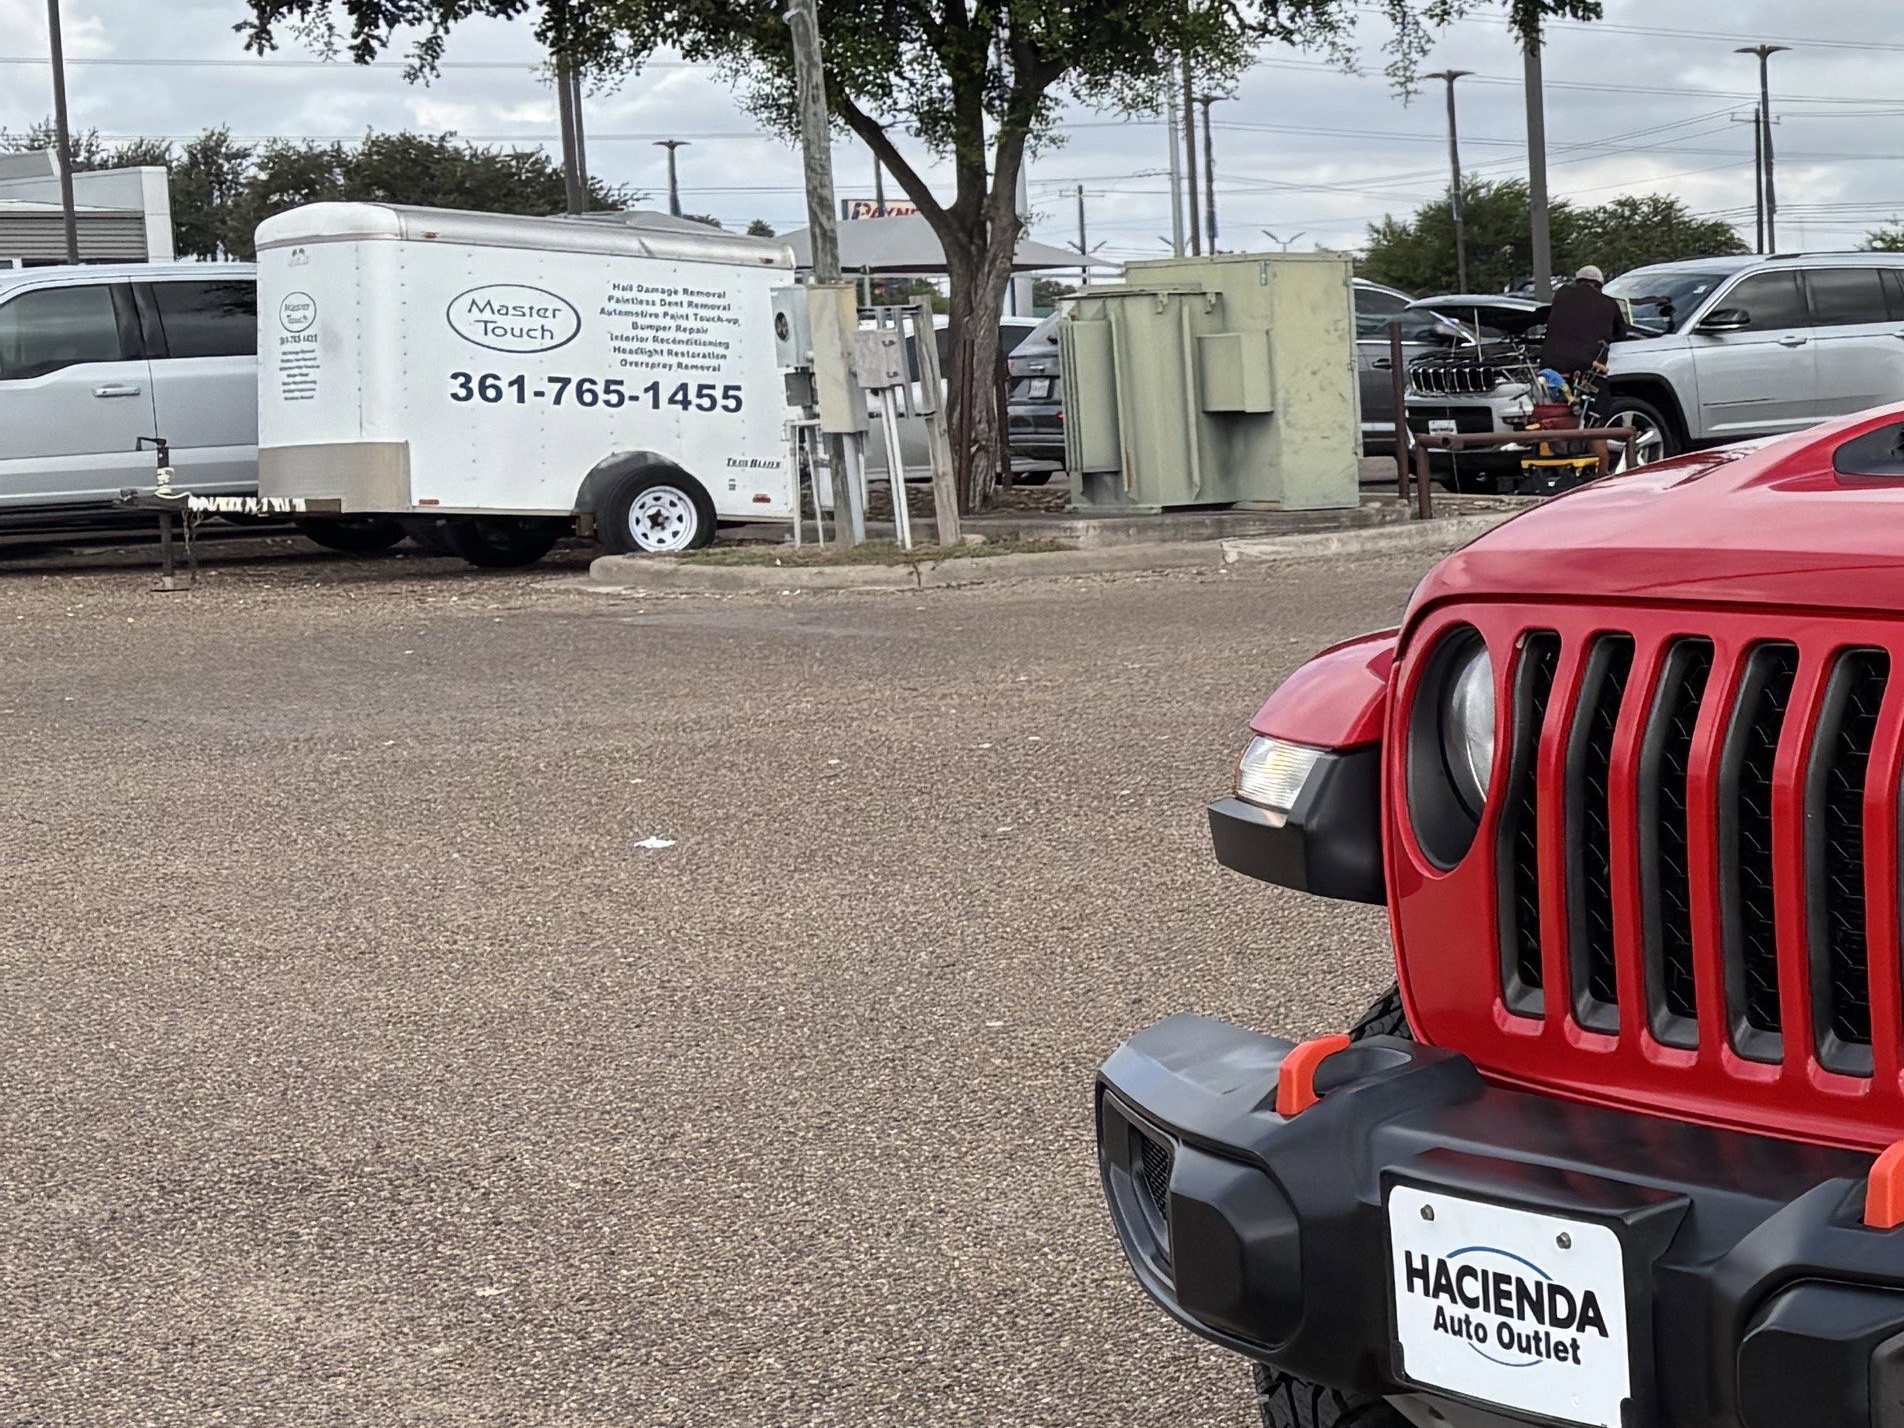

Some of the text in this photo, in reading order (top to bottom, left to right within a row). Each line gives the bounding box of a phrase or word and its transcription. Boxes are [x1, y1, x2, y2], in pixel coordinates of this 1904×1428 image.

[612, 283, 726, 299] Hail Damage Removal
[468, 298, 562, 320] Master
[607, 295, 731, 311] Paintless Dent Removal
[599, 307, 660, 319] Automotive
[663, 311, 689, 321] Paint
[474, 319, 555, 341] Touch
[631, 321, 708, 334] Bumper Repair
[610, 333, 730, 350] Interior Reconditioning
[613, 346, 727, 360] Headlight Restoration
[620, 359, 721, 372] Overspray Removal
[449, 371, 744, 414] 361-765-1455
[1404, 1250, 1610, 1339] HACIENDA
[1433, 1304, 1582, 1366] Auto Outlet
